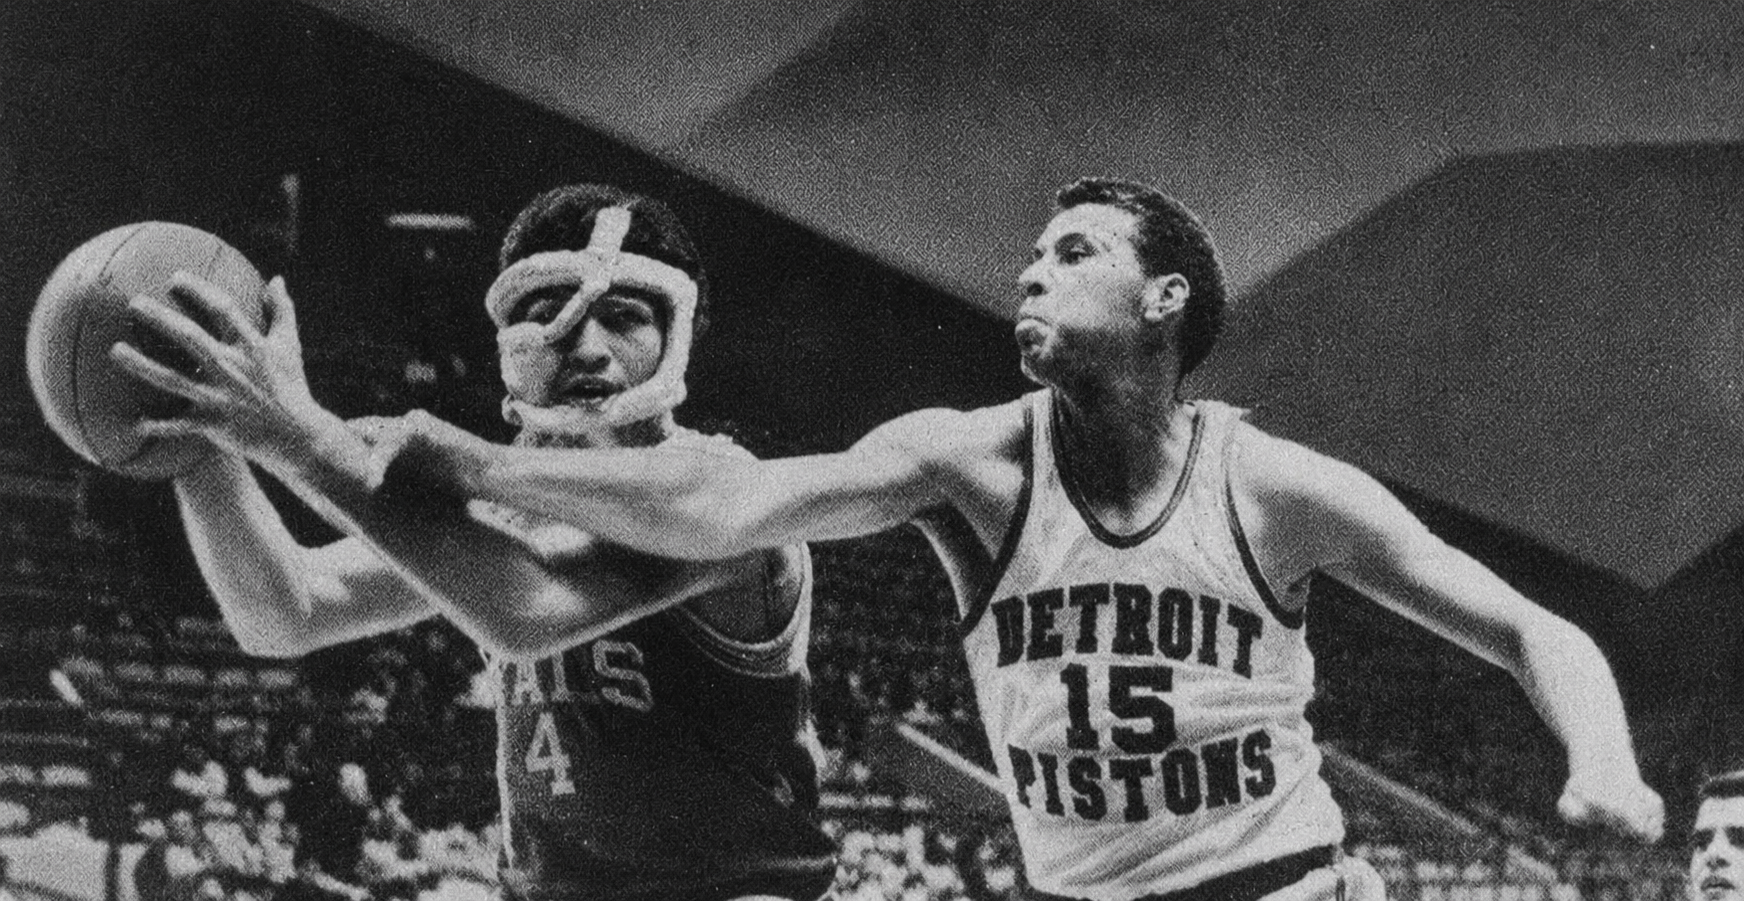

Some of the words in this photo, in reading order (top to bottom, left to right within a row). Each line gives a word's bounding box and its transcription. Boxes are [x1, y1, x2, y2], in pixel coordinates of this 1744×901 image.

[991, 583, 1263, 680] DETROIT
[1060, 662, 1177, 754] 15
[1007, 728, 1277, 823] PISTONS
